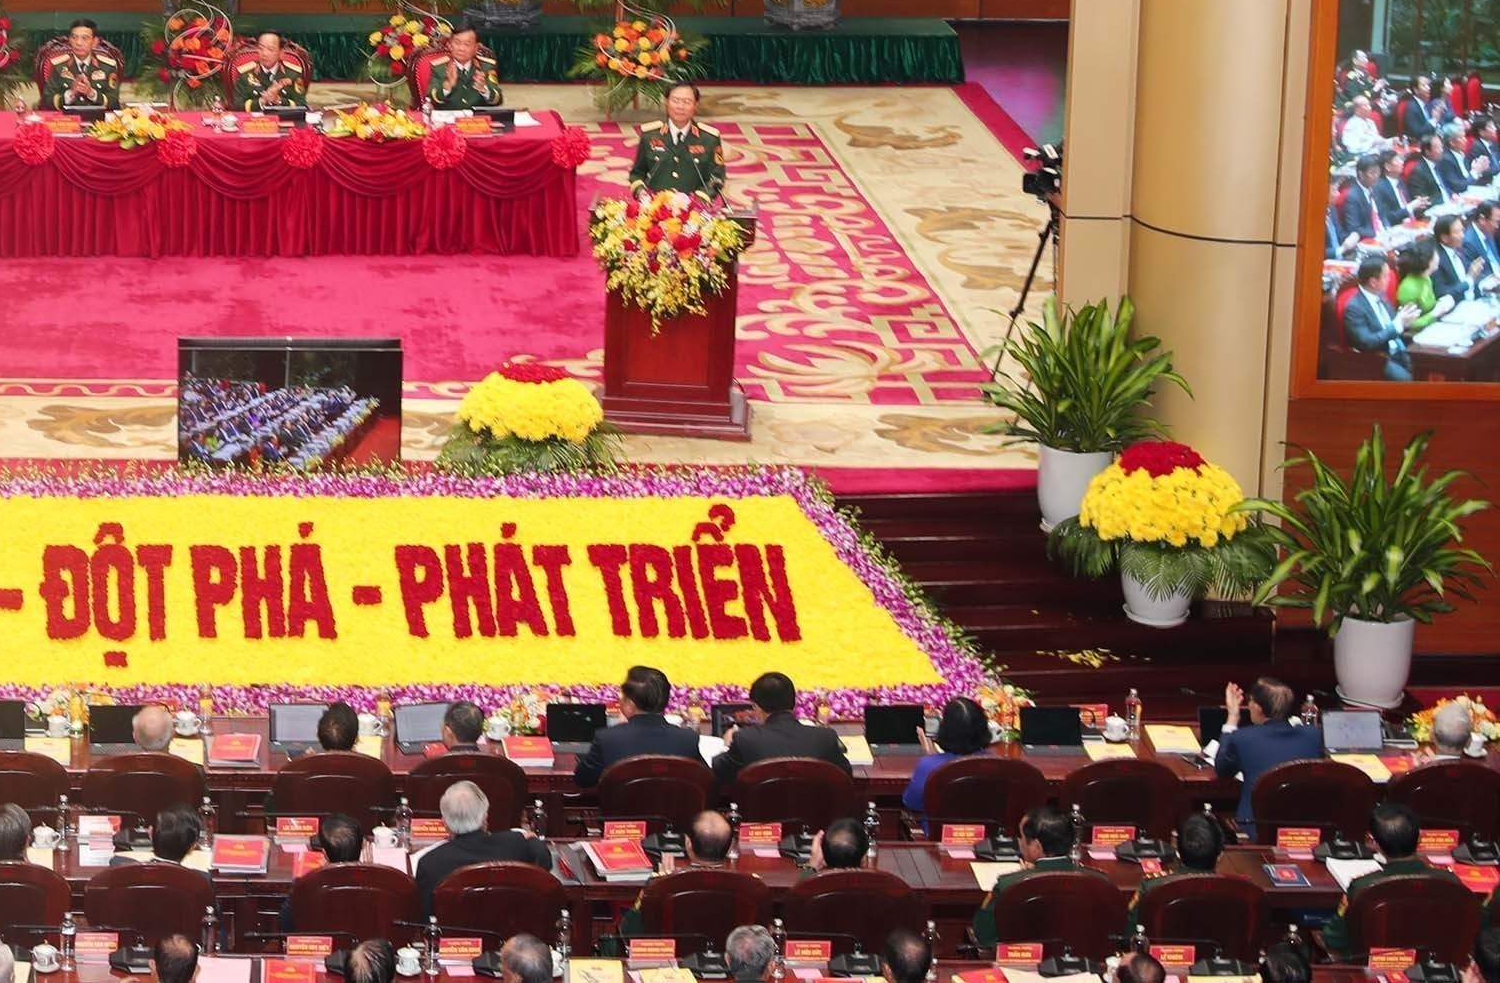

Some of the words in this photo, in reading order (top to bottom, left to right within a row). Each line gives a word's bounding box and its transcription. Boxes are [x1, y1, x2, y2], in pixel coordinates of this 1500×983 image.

[40, 523, 172, 666] ĐỘT
[191, 523, 336, 639] PHÁ
[353, 586, 381, 605] -
[395, 523, 575, 638] PHÁT
[588, 504, 800, 642] TRIỂN
